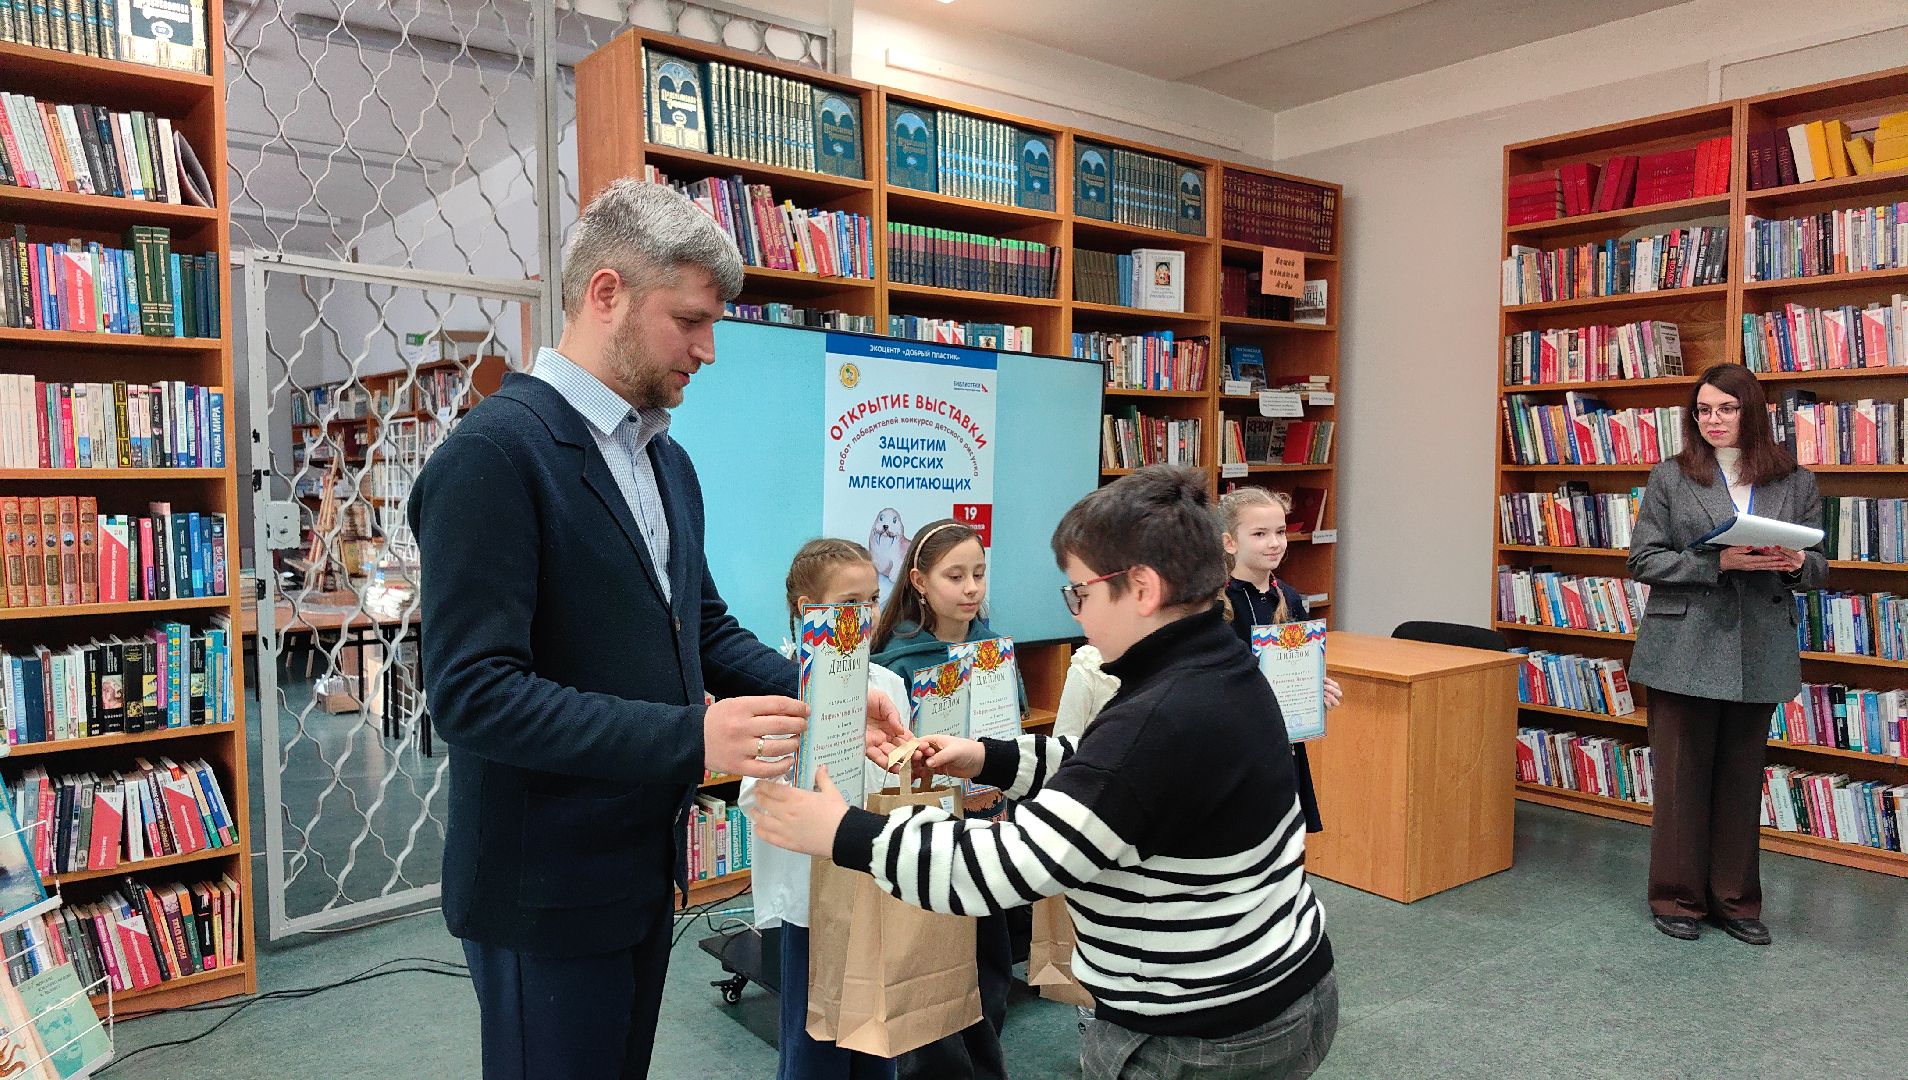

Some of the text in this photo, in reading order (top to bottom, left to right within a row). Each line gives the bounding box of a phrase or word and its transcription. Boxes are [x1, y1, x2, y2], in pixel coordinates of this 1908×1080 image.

[869, 344, 901, 354] ЭКОЦЕНТР
[830, 393, 988, 449] ОТКРЫТИЕ ВЫСТАВКИ
[212, 406, 222, 463] СТРАНЫ МИРА
[839, 417, 979, 477] работ победителей конкурса детского рисунка
[878, 435, 946, 452] ЗАЩИТИМ
[881, 455, 944, 469] МОРСКИХ
[848, 475, 971, 493] МЛЕКОПИТАЮЩИХ
[964, 506, 977, 520] 19
